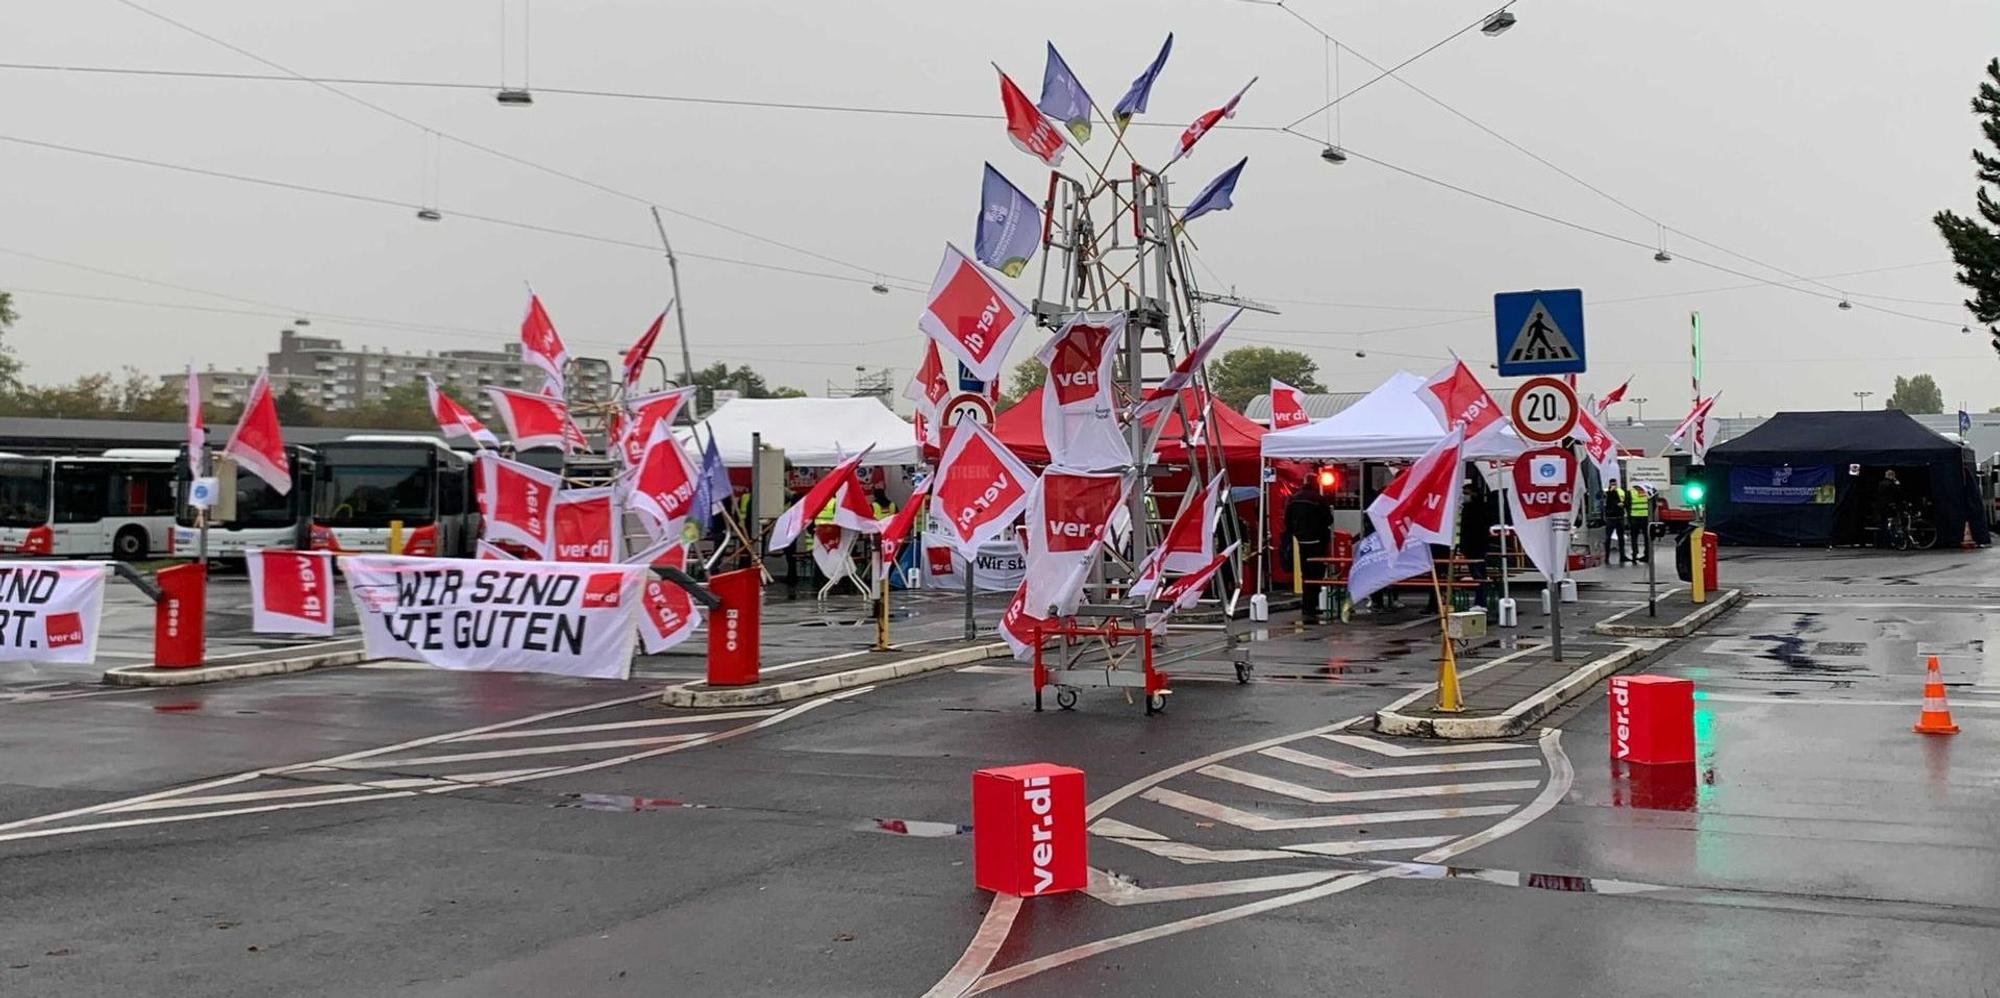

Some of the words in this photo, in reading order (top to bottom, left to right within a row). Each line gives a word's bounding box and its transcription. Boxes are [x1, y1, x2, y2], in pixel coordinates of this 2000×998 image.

[1056, 368, 1096, 387] ver
[1525, 393, 1557, 422] 20
[977, 556, 1003, 570] Wir
[1008, 556, 1027, 570] st
[0, 568, 59, 604] IND
[397, 570, 463, 606] WIR
[472, 571, 581, 606] SIND
[455, 611, 587, 655] GUTEN
[1611, 680, 1629, 758] ver.di
[1028, 776, 1053, 895] ver.di
